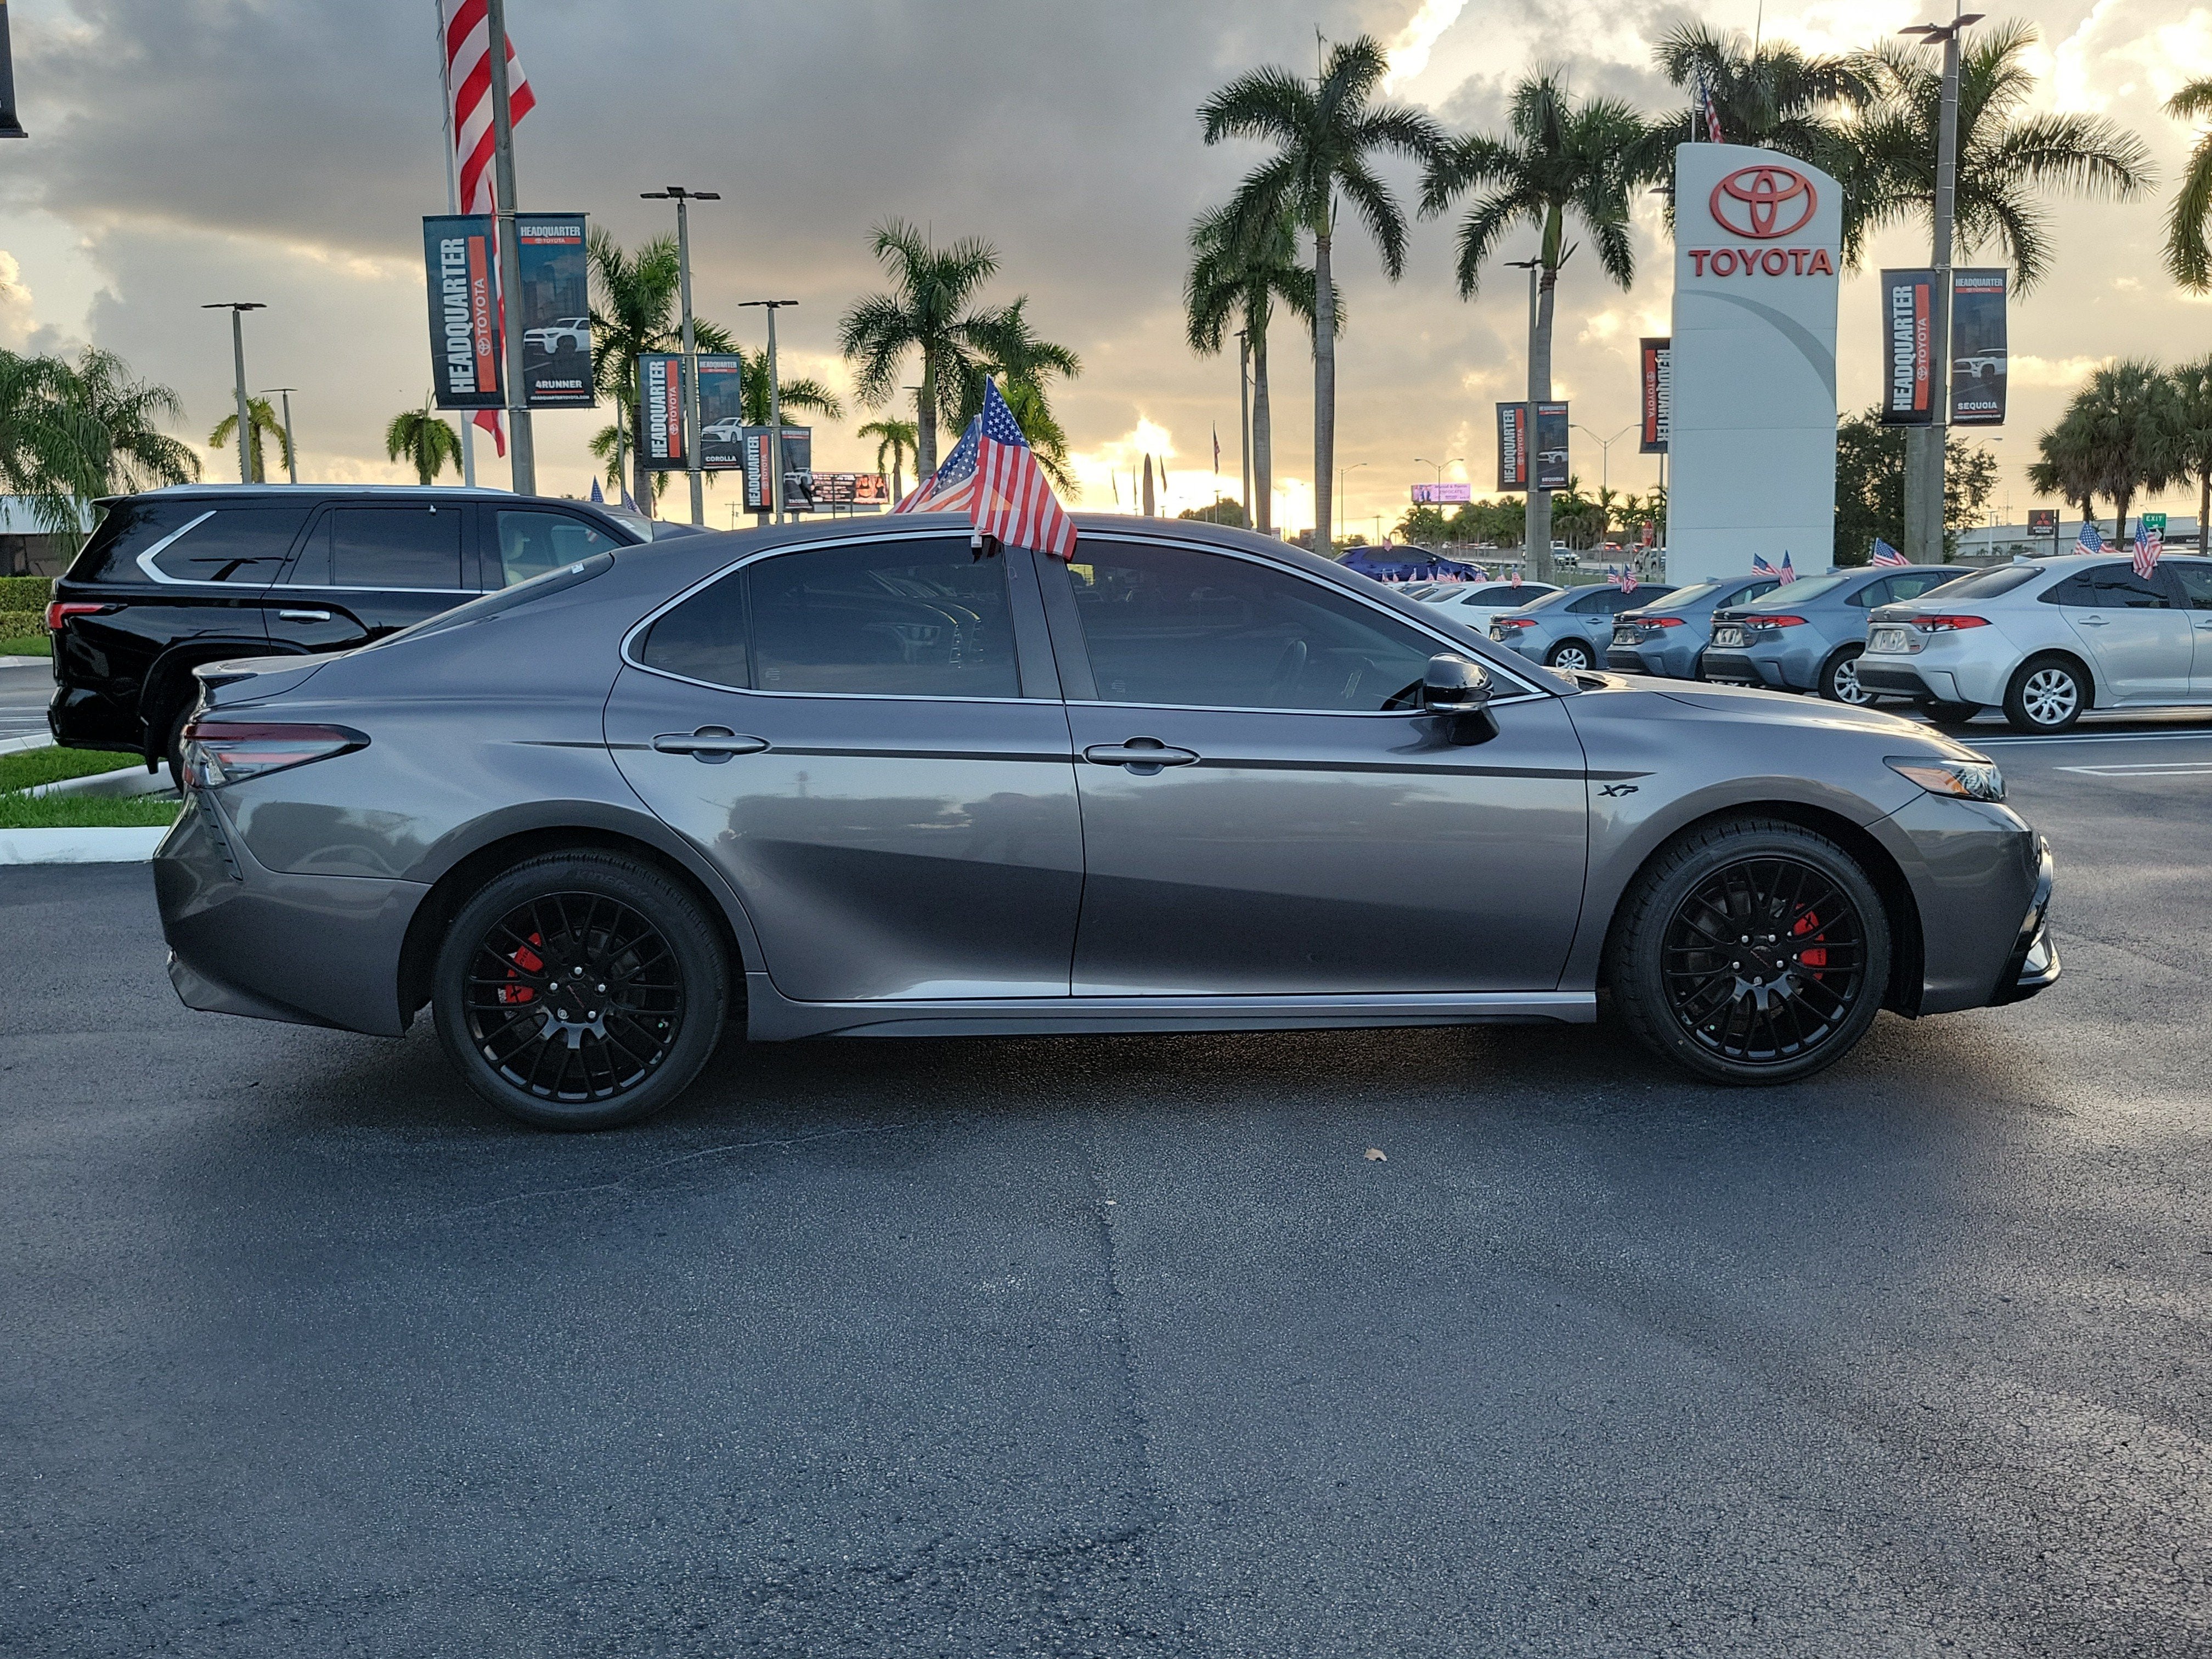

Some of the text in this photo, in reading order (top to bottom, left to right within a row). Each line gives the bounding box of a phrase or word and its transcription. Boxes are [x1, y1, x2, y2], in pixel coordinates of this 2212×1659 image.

[520, 226, 581, 238] HEADQUARTER
[1689, 249, 1833, 276] TOYOTA
[1955, 278, 2002, 287] HEADQUARTER
[441, 238, 476, 393] HEADQUARTER
[474, 278, 488, 336] TOYOTA
[1893, 285, 1916, 411] HEADQUARTER
[1917, 317, 1927, 365] TOYOTA
[535, 380, 583, 388] 4RUNNER
[670, 386, 678, 422] TOYOTA
[1646, 382, 1655, 418] TOYOTA
[650, 361, 668, 458] HEADQUARTER
[1957, 402, 1997, 410] SEQUOIA
[1503, 409, 1517, 483] HEADQUARTER
[748, 436, 761, 506] HEADQUARTER
